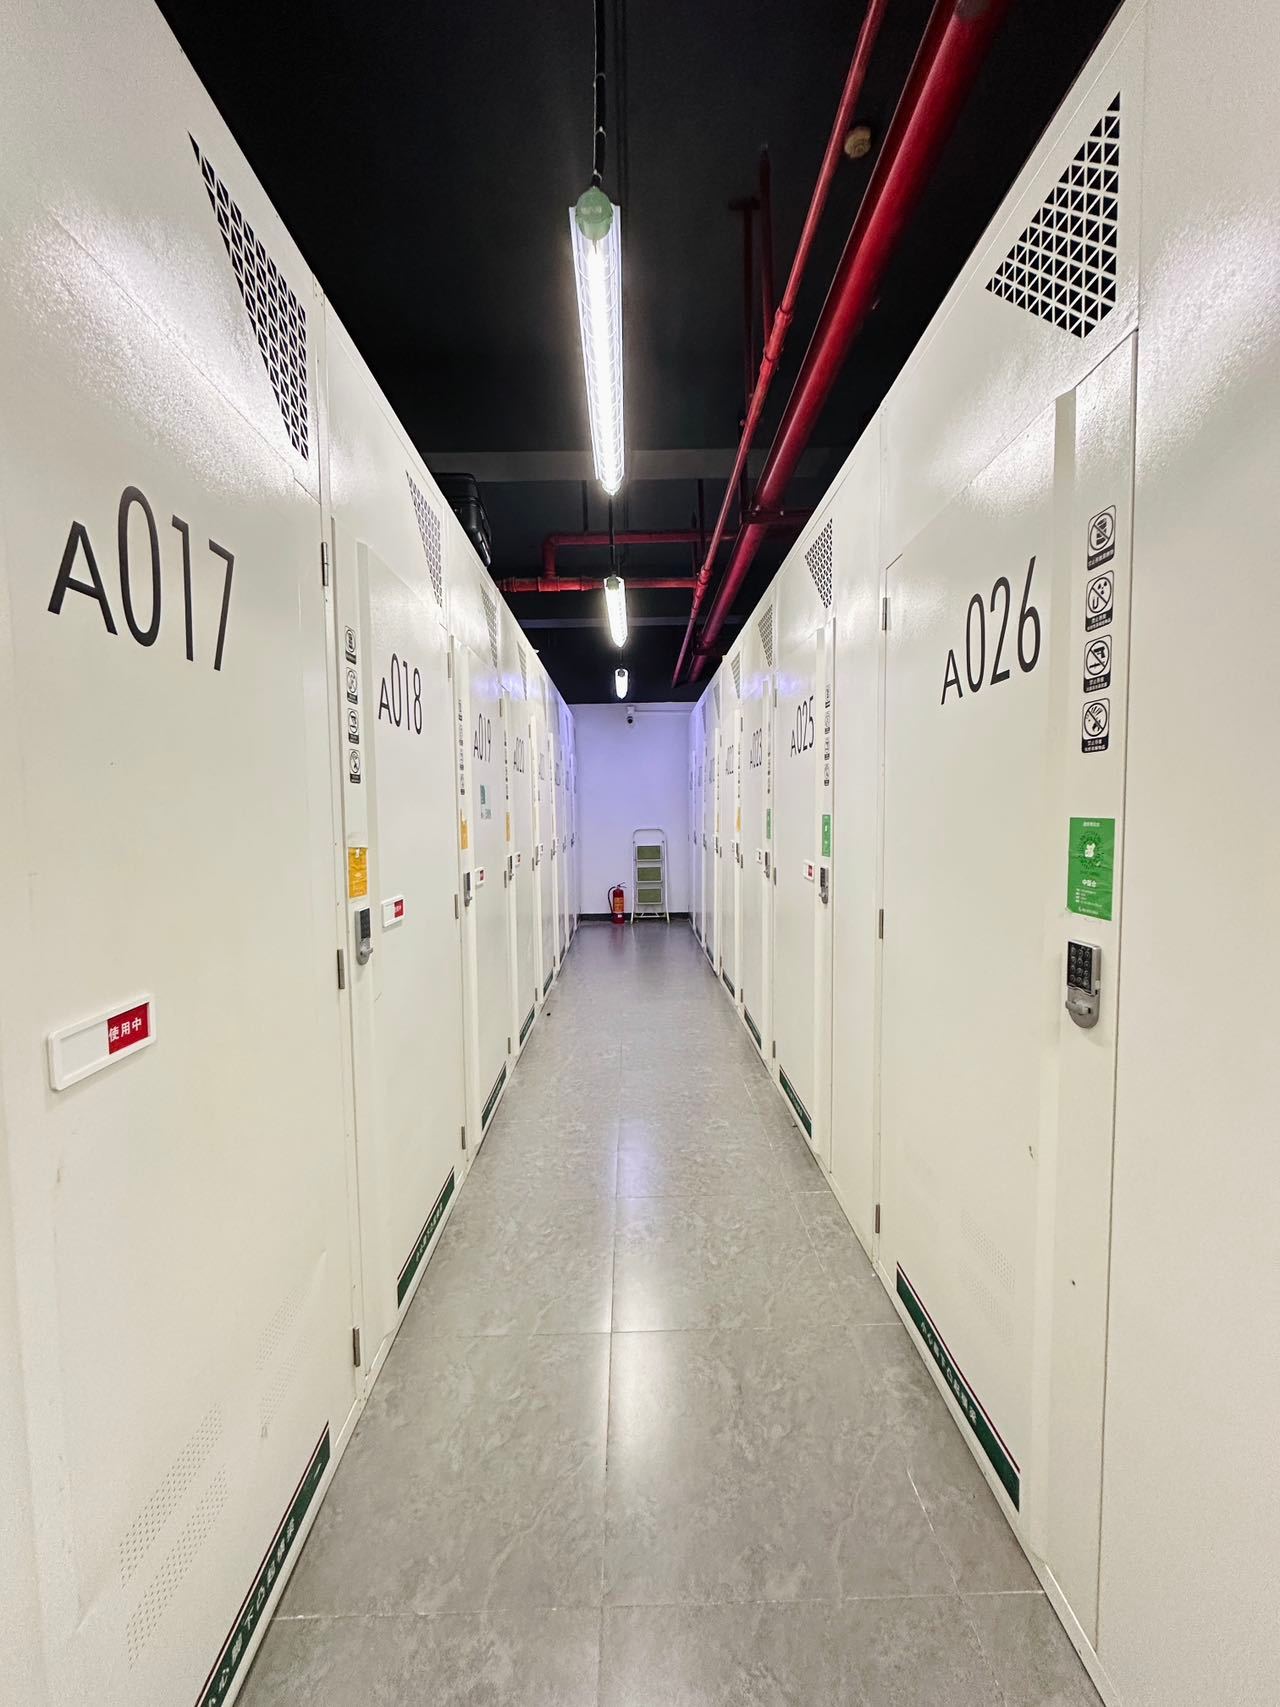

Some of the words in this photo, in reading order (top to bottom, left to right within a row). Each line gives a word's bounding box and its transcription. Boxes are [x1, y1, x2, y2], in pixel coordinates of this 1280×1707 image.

[48, 486, 235, 672] A017
[941, 555, 1041, 705] A026
[378, 653, 423, 735] A018
[790, 695, 815, 757] A025
[473, 713, 492, 763] A019
[109, 1017, 142, 1043] 使用中
